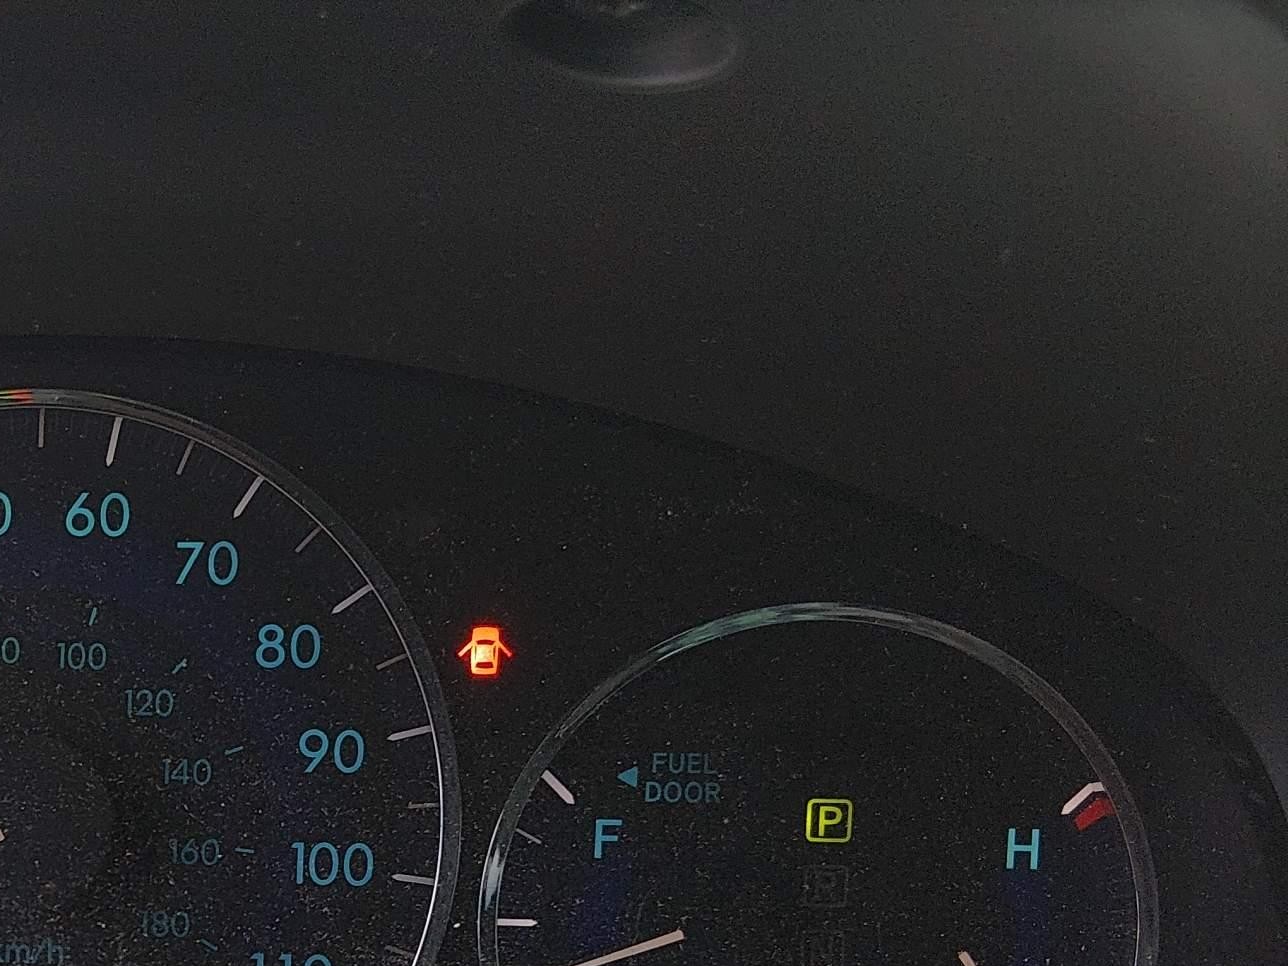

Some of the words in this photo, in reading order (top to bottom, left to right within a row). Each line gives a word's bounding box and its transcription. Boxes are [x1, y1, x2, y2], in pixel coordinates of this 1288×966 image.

[64, 490, 131, 537] 60
[175, 540, 240, 586] 70
[57, 641, 108, 672] 100
[255, 623, 321, 669] 80
[125, 688, 175, 719] 120
[298, 728, 366, 774] 90
[651, 752, 716, 775] FUEL
[162, 758, 212, 786] 140
[644, 780, 720, 803] DOOR
[818, 806, 843, 837] P
[169, 838, 220, 866] 160
[593, 818, 623, 859] F
[1005, 827, 1041, 870] H
[291, 841, 376, 887] 100
[141, 911, 192, 938] 180
